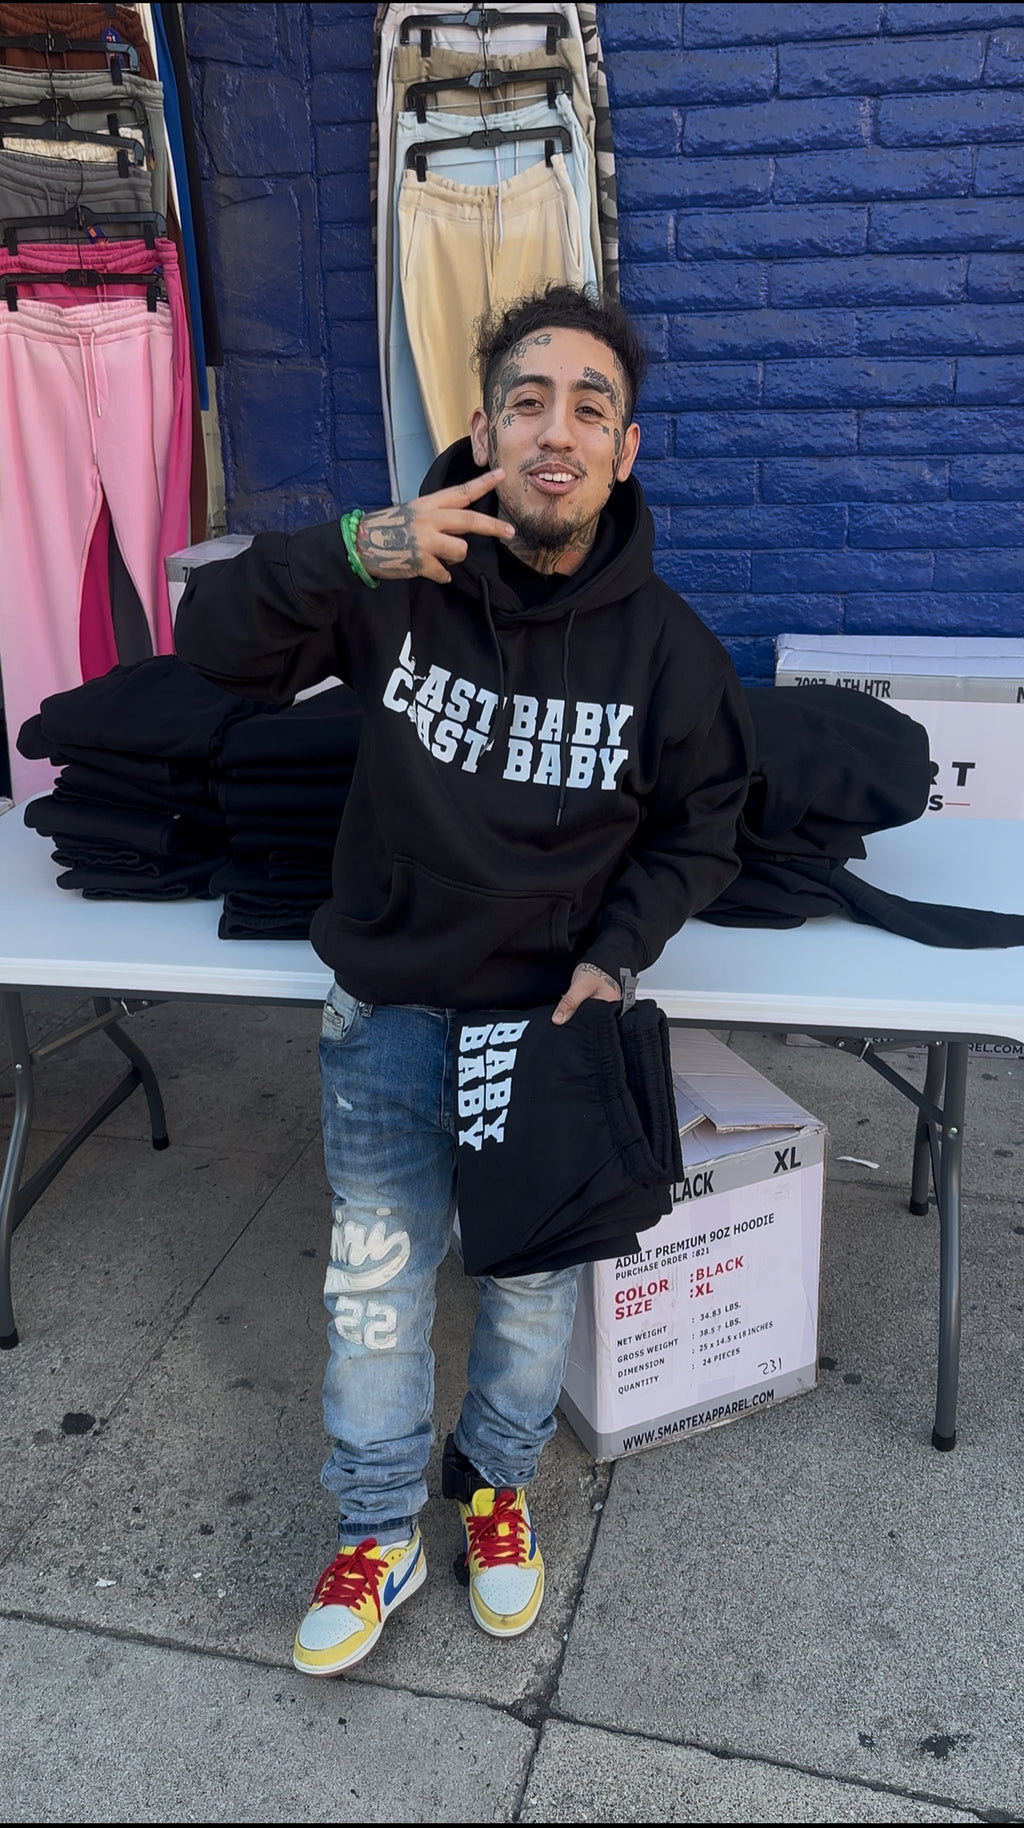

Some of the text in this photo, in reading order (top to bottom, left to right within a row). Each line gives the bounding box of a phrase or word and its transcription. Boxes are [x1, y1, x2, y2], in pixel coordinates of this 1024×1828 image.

[864, 679, 891, 698] HTR
[509, 694, 634, 746] BABY
[503, 738, 629, 790] BABY
[458, 1024, 494, 1151] BABY
[484, 1020, 530, 1143] BABY
[773, 1146, 801, 1174] XL
[672, 1170, 715, 1204] LACK
[615, 1213, 774, 1270] ADULT PREMIUM 9OZ HOODIE
[615, 1262, 659, 1280] PURCHASE
[661, 1252, 688, 1267] ORDER
[614, 1278, 669, 1304] COLOR
[615, 1299, 652, 1320] SIZE
[617, 1336, 632, 1347] NET
[635, 1325, 667, 1341] WEIGHT
[617, 1349, 645, 1363] GROSS
[647, 1338, 678, 1354] WEIGHT
[617, 1357, 665, 1378] DIMENSION
[617, 1375, 659, 1395] QUANTITY
[702, 1357, 711, 1366] 24
[713, 1347, 740, 1362] PIECES
[622, 1388, 775, 1451] WWW.SMARTEXAPPAREL.COM
